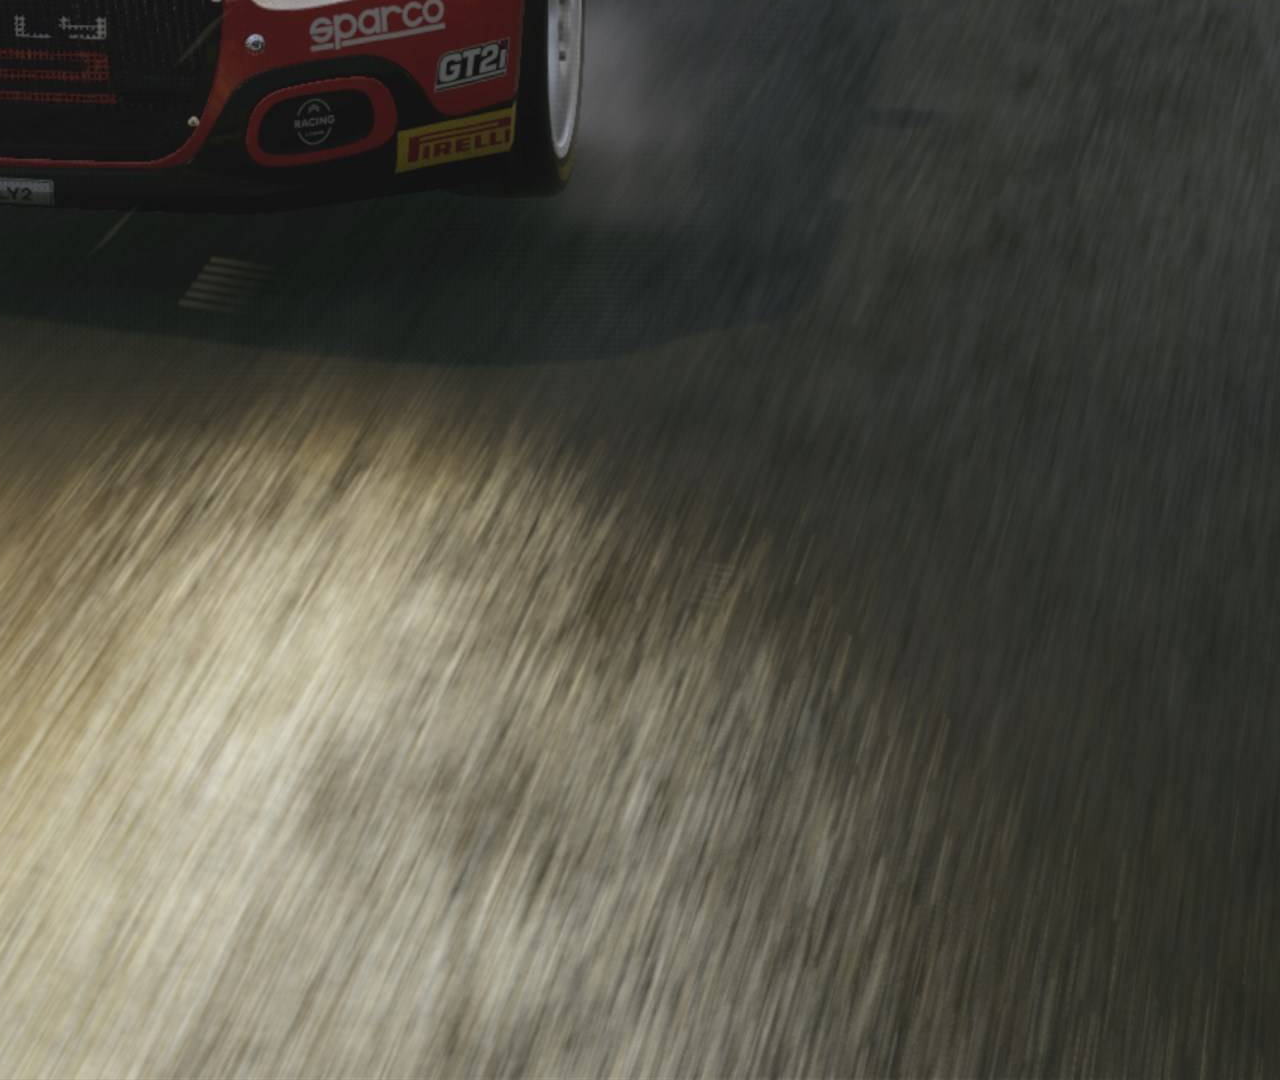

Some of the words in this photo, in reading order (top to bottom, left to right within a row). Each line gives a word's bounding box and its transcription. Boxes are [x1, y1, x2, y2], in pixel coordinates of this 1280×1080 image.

[437, 40, 508, 85] GT2i
[294, 114, 335, 128] RACING
[407, 117, 511, 163] PIRELLI
